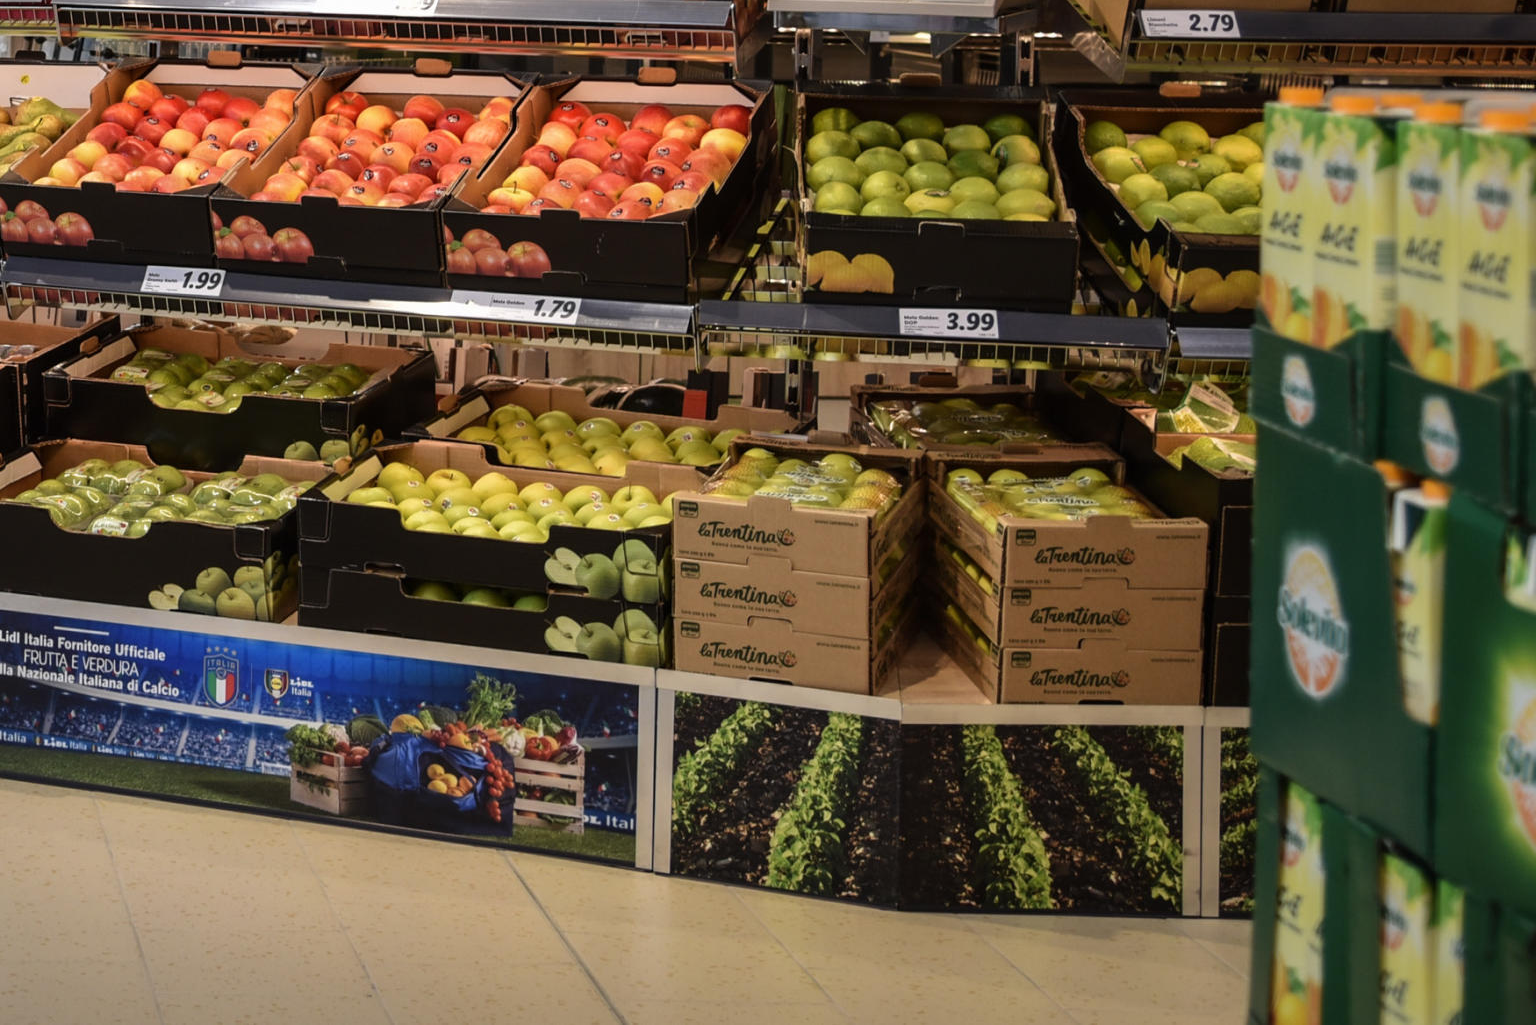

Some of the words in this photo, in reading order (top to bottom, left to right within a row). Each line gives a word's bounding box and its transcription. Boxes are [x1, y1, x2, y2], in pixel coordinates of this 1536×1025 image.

[1189, 14, 1234, 32] 2.79
[183, 271, 222, 290] 1.99
[533, 299, 576, 318] 1.79
[947, 313, 994, 331] 3.99
[24, 632, 54, 648] Italia
[57, 637, 111, 655] Fornitore
[115, 642, 166, 662] Ufficiale
[24, 649, 66, 668] FRUTTA
[72, 655, 78, 670] E
[80, 656, 139, 677] VERDURA
[207, 659, 235, 669] ITALIA
[17, 666, 75, 684] Nazionale
[78, 672, 123, 690] Italiana
[127, 677, 138, 691] di
[142, 680, 179, 698] Calcio
[292, 687, 311, 697] Italia
[0, 730, 26, 743] Italia
[70, 741, 87, 751] Italia
